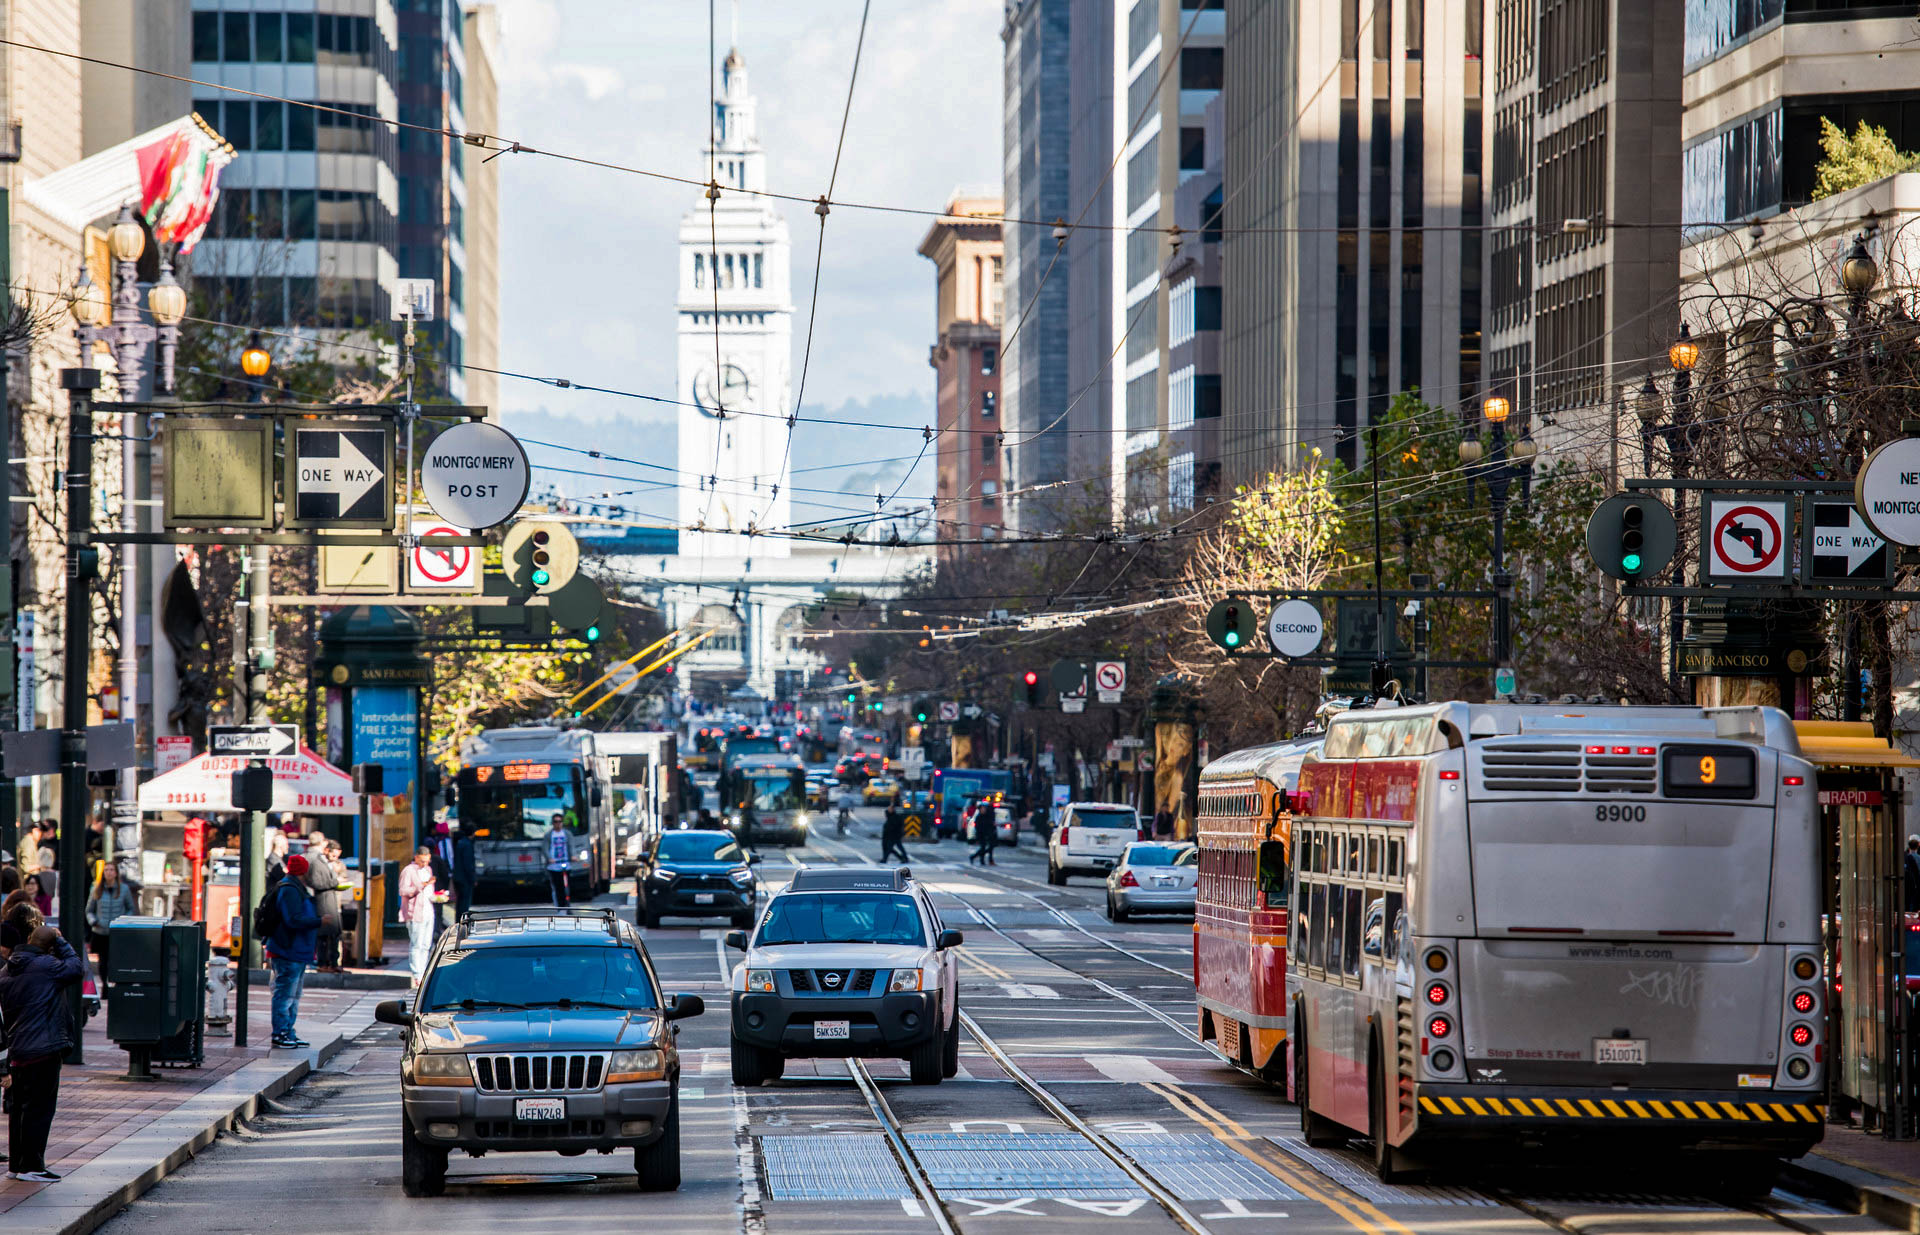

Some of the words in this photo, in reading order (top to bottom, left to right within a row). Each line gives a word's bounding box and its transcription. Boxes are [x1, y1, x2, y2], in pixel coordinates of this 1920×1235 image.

[432, 456, 515, 469] MONTGOMERY
[302, 469, 332, 482] ONE
[343, 469, 375, 482] WAY
[1900, 472, 1920, 485] NE
[448, 485, 498, 498] POST
[1816, 536, 1842, 547] ONE
[1851, 536, 1878, 548] WAY
[1275, 623, 1318, 634] SECOND
[1685, 655, 1700, 667] SAN
[1703, 654, 1769, 667] FRANCISCO
[360, 726, 387, 735] FREE
[218, 735, 240, 748] ONE
[247, 735, 270, 747] WAY
[373, 738, 410, 750] grocery
[371, 749, 411, 762] delivery
[201, 758, 239, 771] DOSA
[244, 758, 319, 775] BOTHERS
[1700, 756, 1716, 784] 9
[167, 793, 207, 804] DOSAS
[297, 794, 344, 807] DRINKS
[1831, 791, 1867, 804] RAPID
[1595, 805, 1646, 823] 8900
[1569, 946, 1673, 959] www.sfmta.com
[816, 1027, 848, 1037] 5WKS524
[1487, 1049, 1513, 1059] Stop
[1516, 1049, 1544, 1059] Back
[1547, 1050, 1554, 1059] 5
[1557, 1050, 1582, 1060] Feet
[1599, 1048, 1643, 1061] 1510071
[900, 1198, 1289, 1218] TAXI
